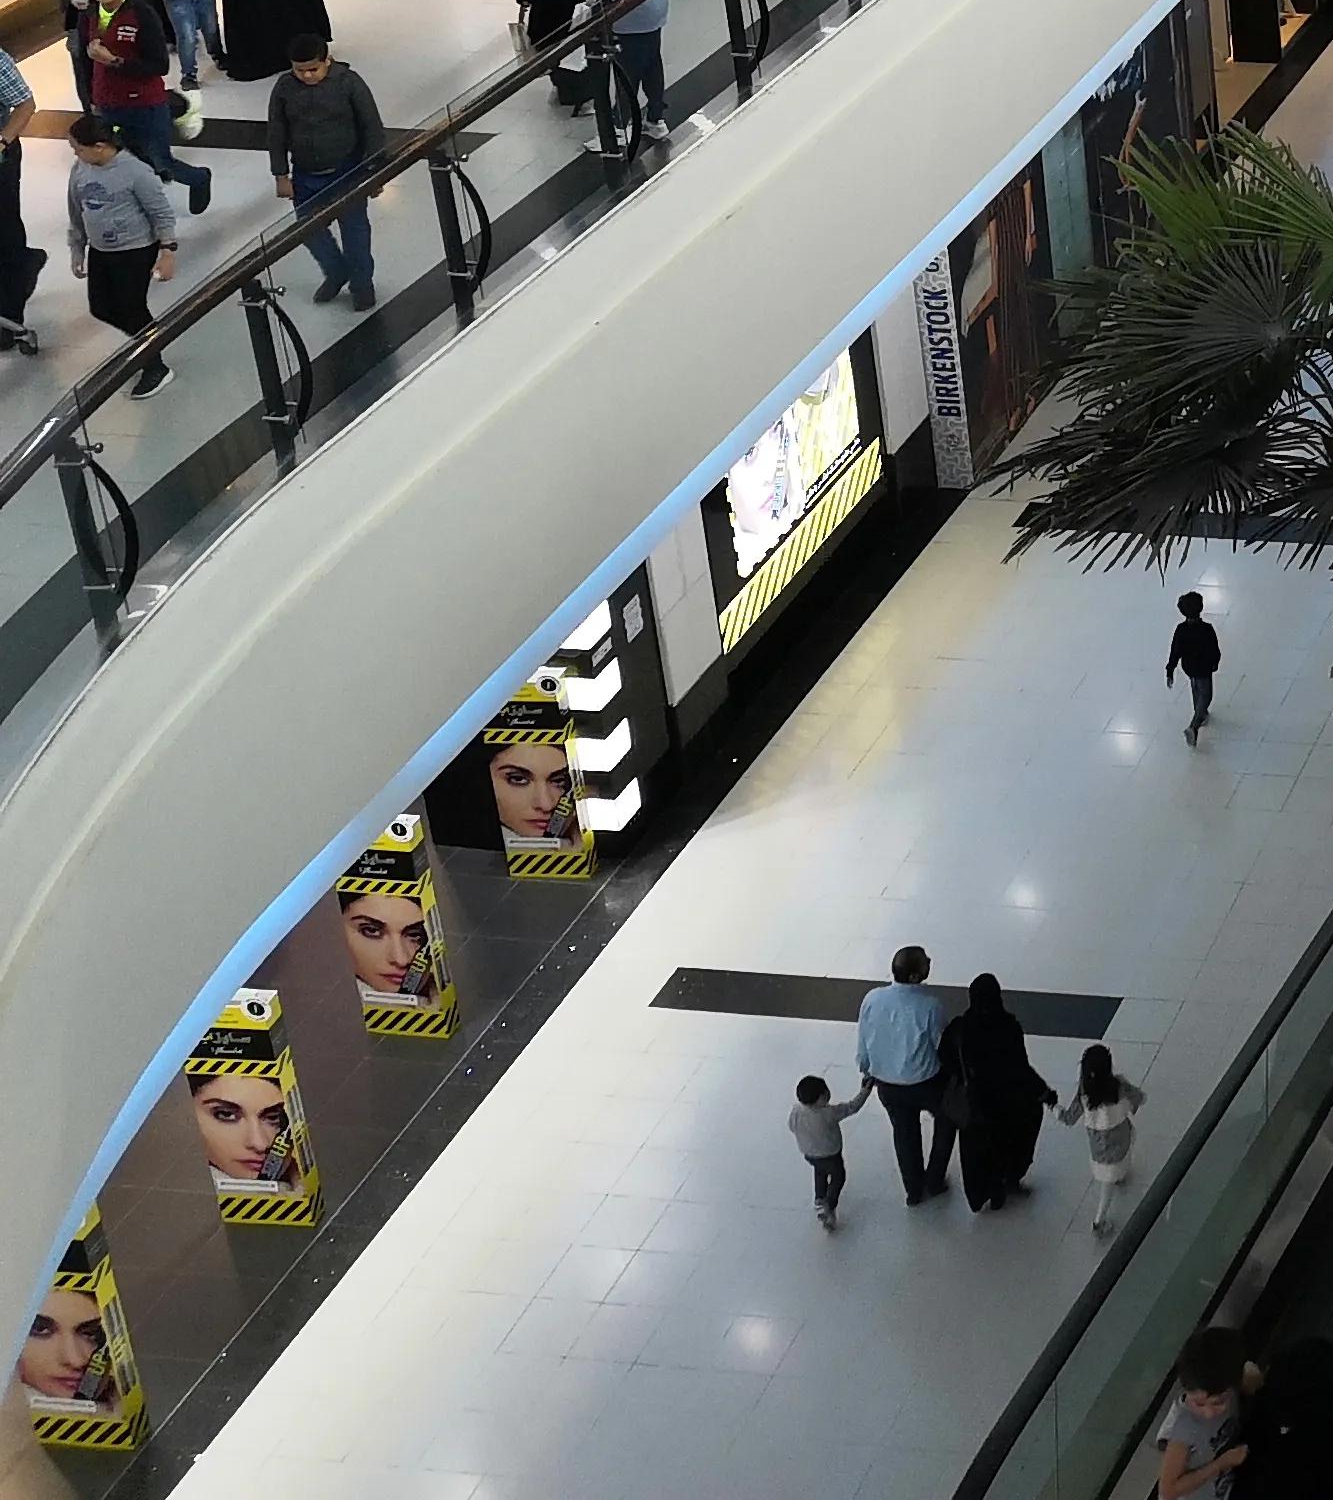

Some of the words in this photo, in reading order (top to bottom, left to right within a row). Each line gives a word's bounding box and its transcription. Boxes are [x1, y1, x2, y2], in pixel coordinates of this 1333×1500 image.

[922, 285, 961, 418] BIRKENSTOCK
[410, 950, 430, 974] UP
[272, 1133, 293, 1158] UP
